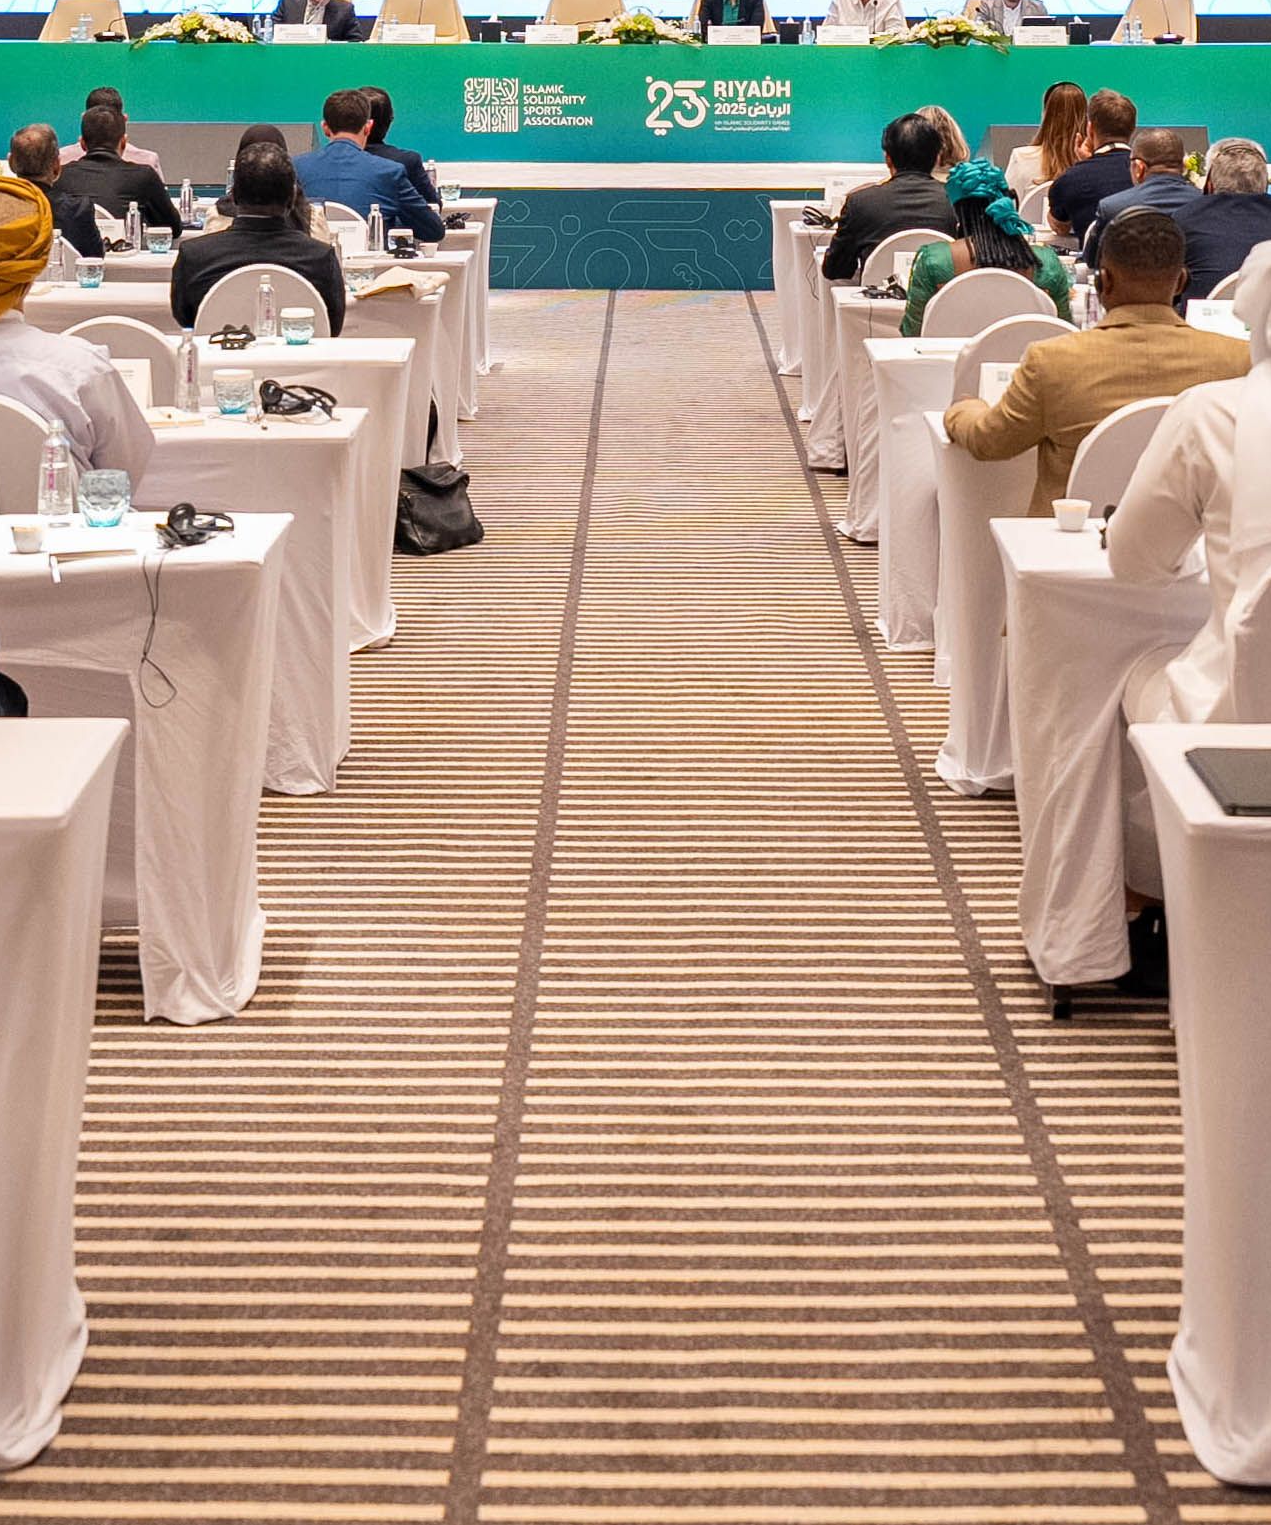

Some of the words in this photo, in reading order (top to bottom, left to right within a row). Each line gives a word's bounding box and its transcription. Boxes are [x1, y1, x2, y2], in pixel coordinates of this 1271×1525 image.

[523, 84, 564, 94] ISLAMIC
[713, 79, 791, 98] RIYADH
[523, 95, 586, 105] SOLIDARITY
[523, 106, 563, 115] SPORTS
[714, 102, 747, 115] 2025
[747, 102, 790, 118] الرياض
[522, 116, 593, 126] ASSOCIATION
